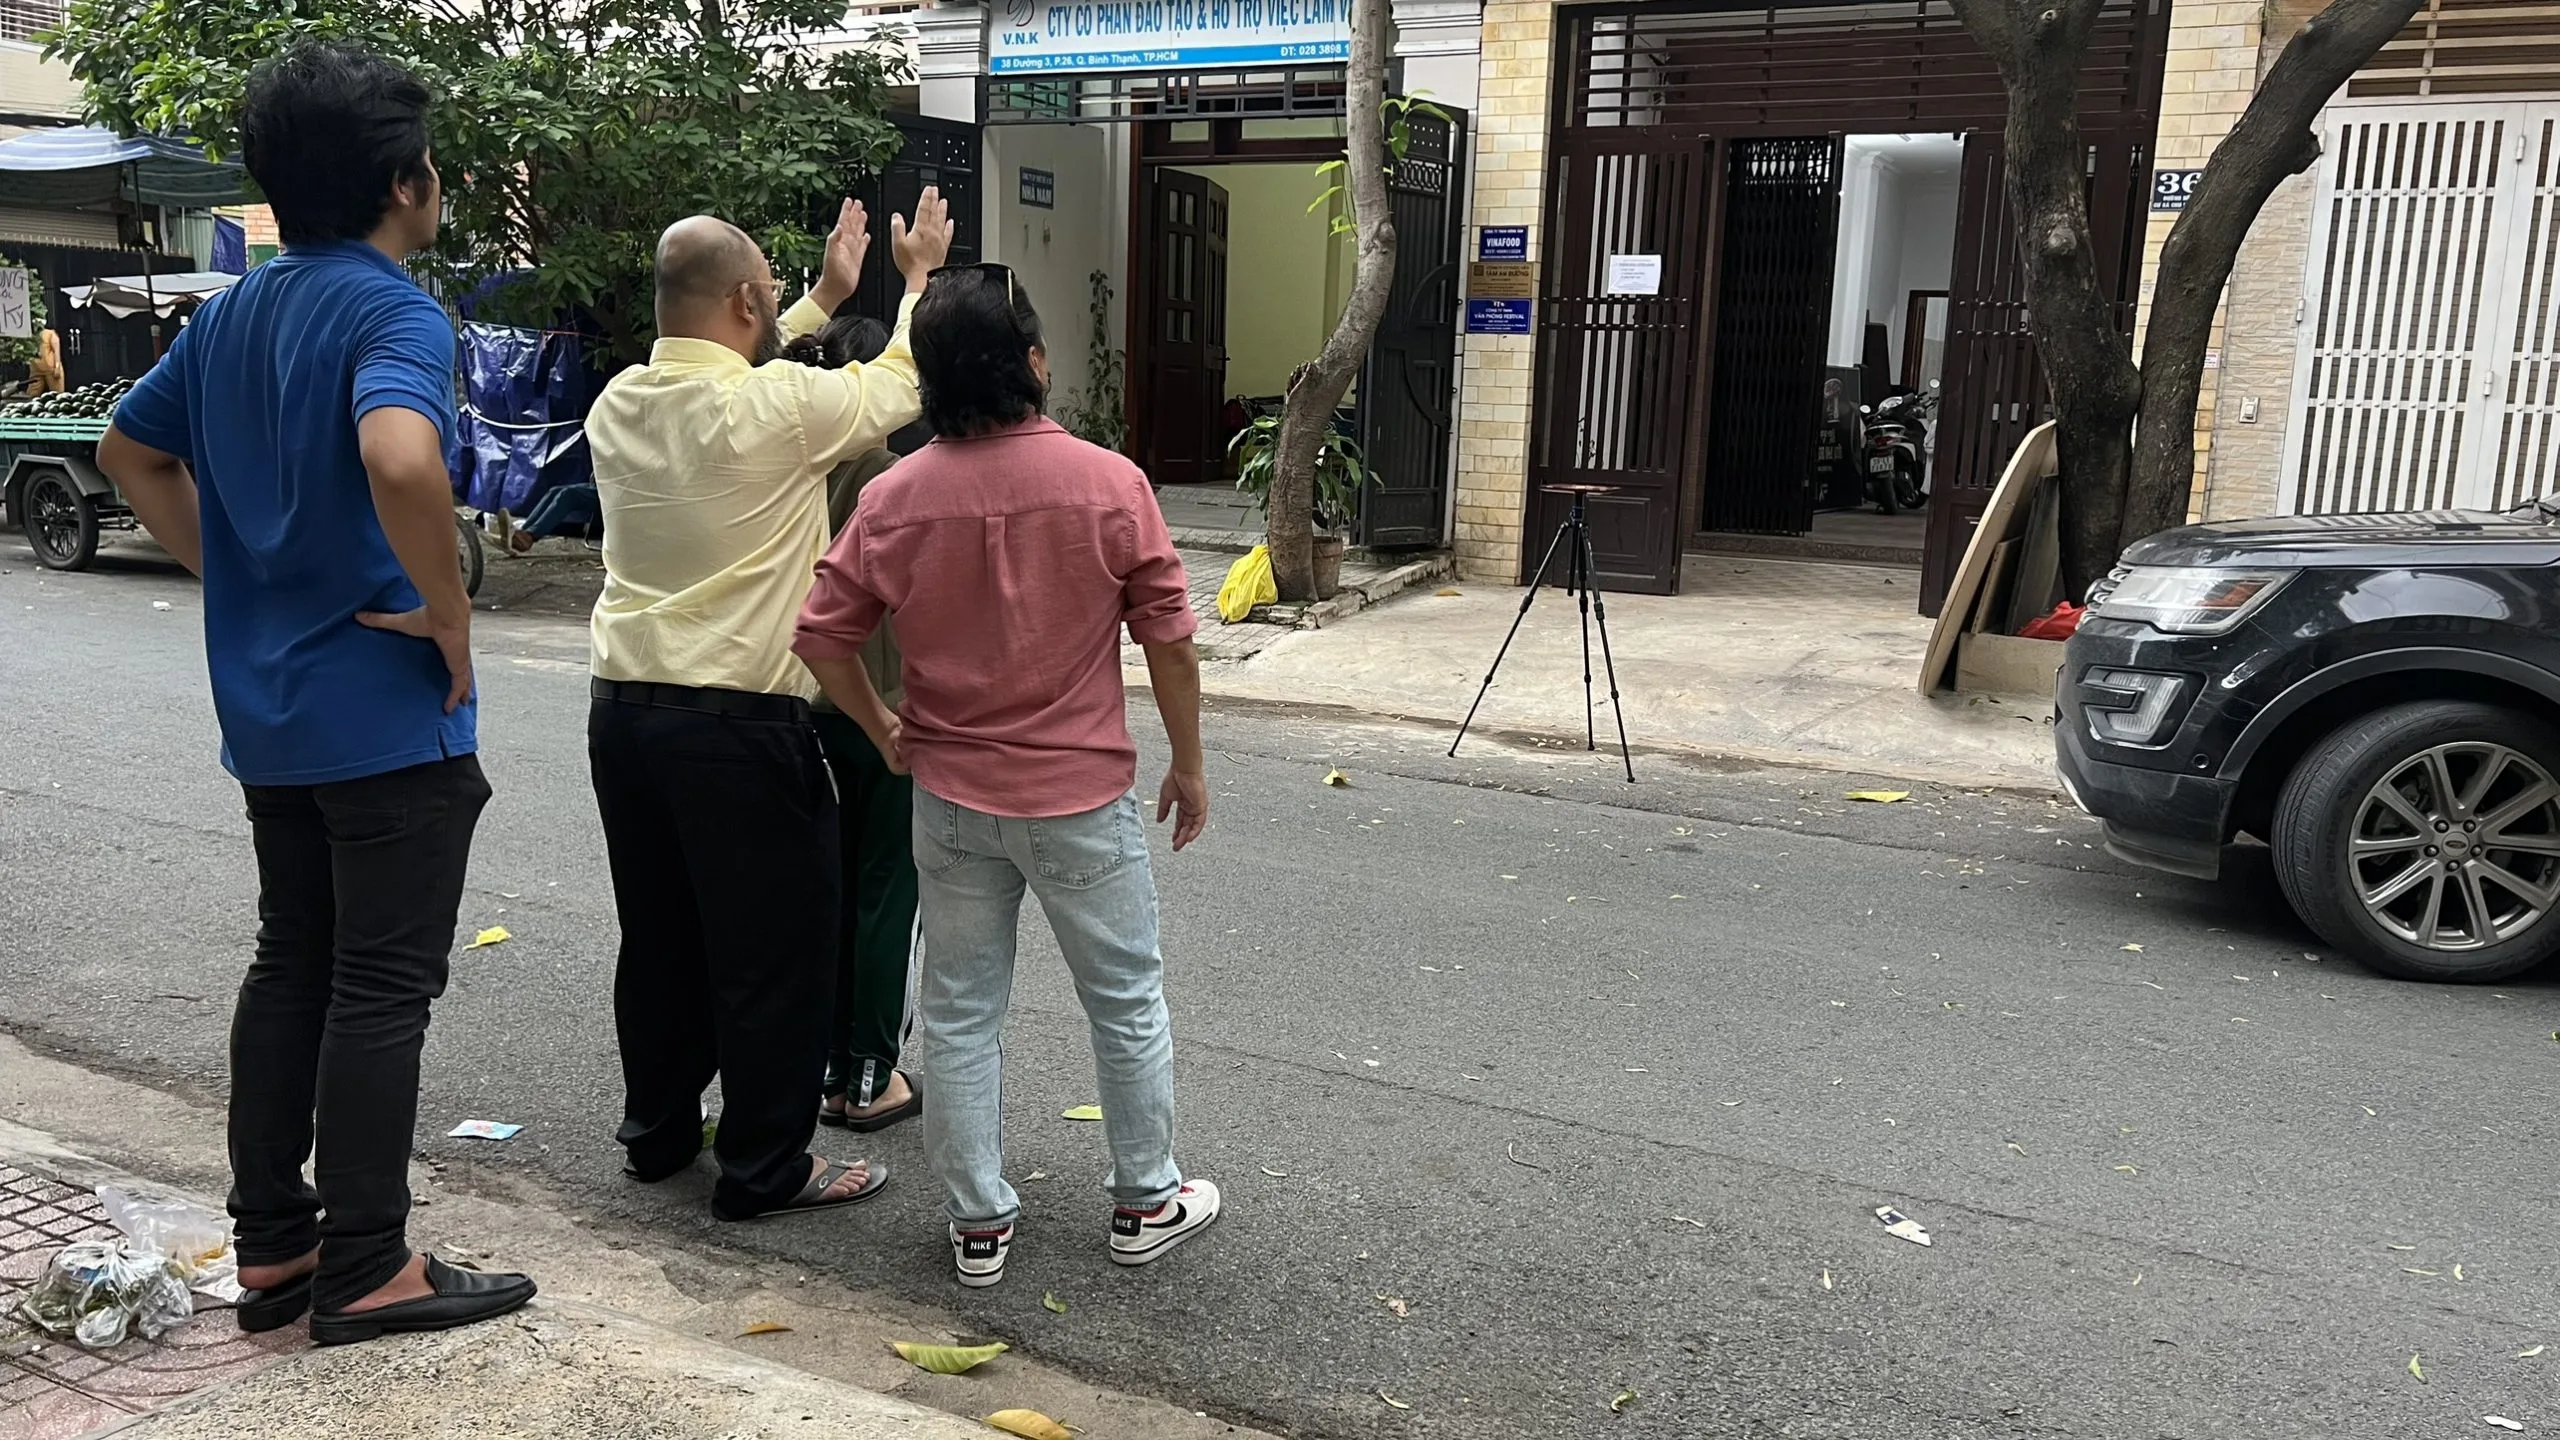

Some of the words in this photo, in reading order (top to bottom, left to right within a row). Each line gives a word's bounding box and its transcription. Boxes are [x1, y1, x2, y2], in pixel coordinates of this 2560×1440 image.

[1048, 5, 1072, 38] CTY
[1166, 0, 1193, 38] TẠO
[1197, 0, 1208, 30] &
[1003, 32, 1039, 45] V.N.K
[1280, 46, 1296, 57] ĐT:
[1299, 45, 1316, 55] 028
[1319, 44, 1342, 55] 3898
[1001, 58, 1011, 68] 38
[1143, 51, 1179, 62] TP.HCM
[2157, 172, 2202, 194] 36
[1037, 187, 1052, 204] NAM
[1486, 237, 1521, 247] VINAFOOD
[1115, 1218, 1132, 1229] NIKE
[970, 1240, 991, 1251] NIKE
